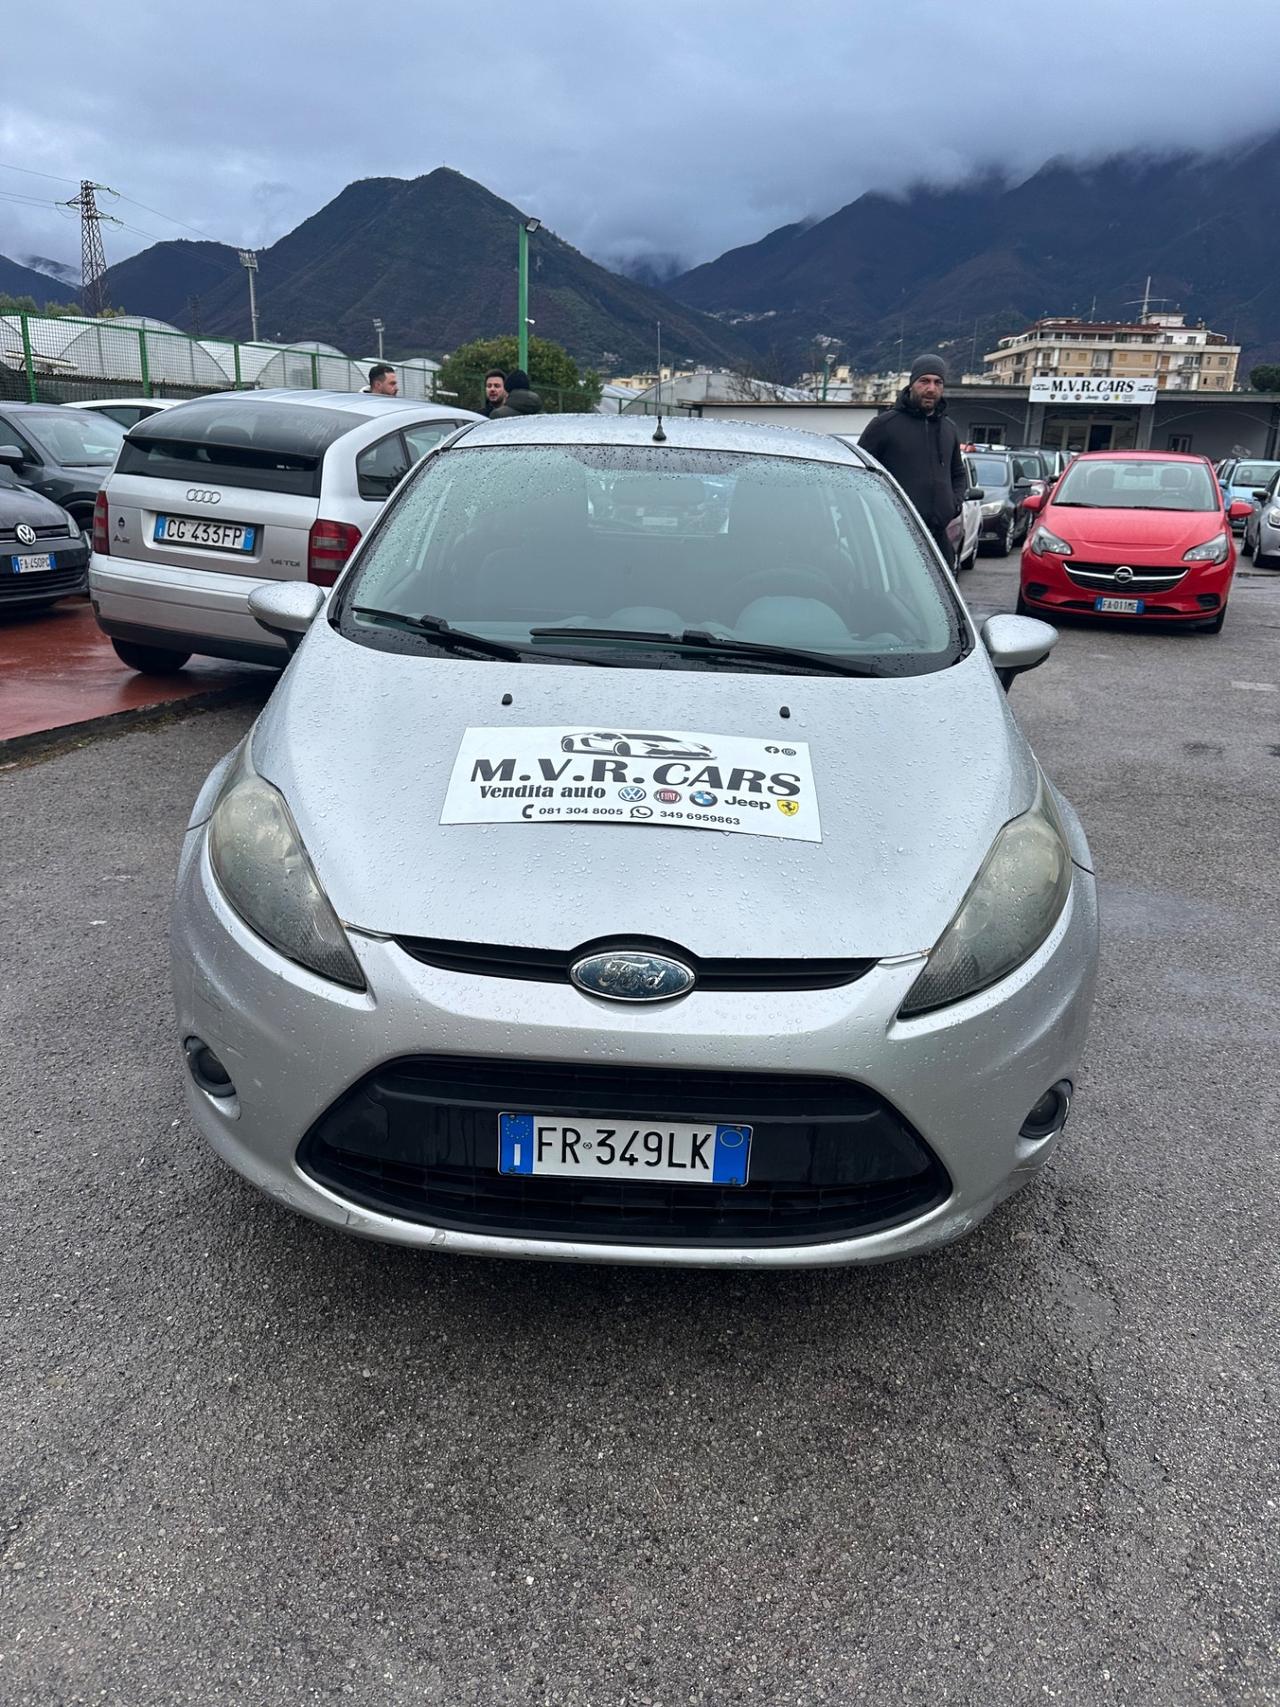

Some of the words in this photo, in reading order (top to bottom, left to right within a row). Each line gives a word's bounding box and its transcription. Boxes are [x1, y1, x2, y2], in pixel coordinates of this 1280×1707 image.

[167, 519, 187, 539] CG
[191, 523, 243, 546] 433FP
[479, 784, 555, 799] Vendita
[560, 785, 607, 799] auto
[538, 807, 561, 815] 081
[565, 807, 589, 815] 304
[592, 807, 624, 816] 8005
[724, 796, 771, 811] Jeep
[659, 810, 683, 819] 349
[686, 812, 741, 826] 6959863
[599, 959, 666, 991] Ford
[537, 1126, 581, 1164] FR
